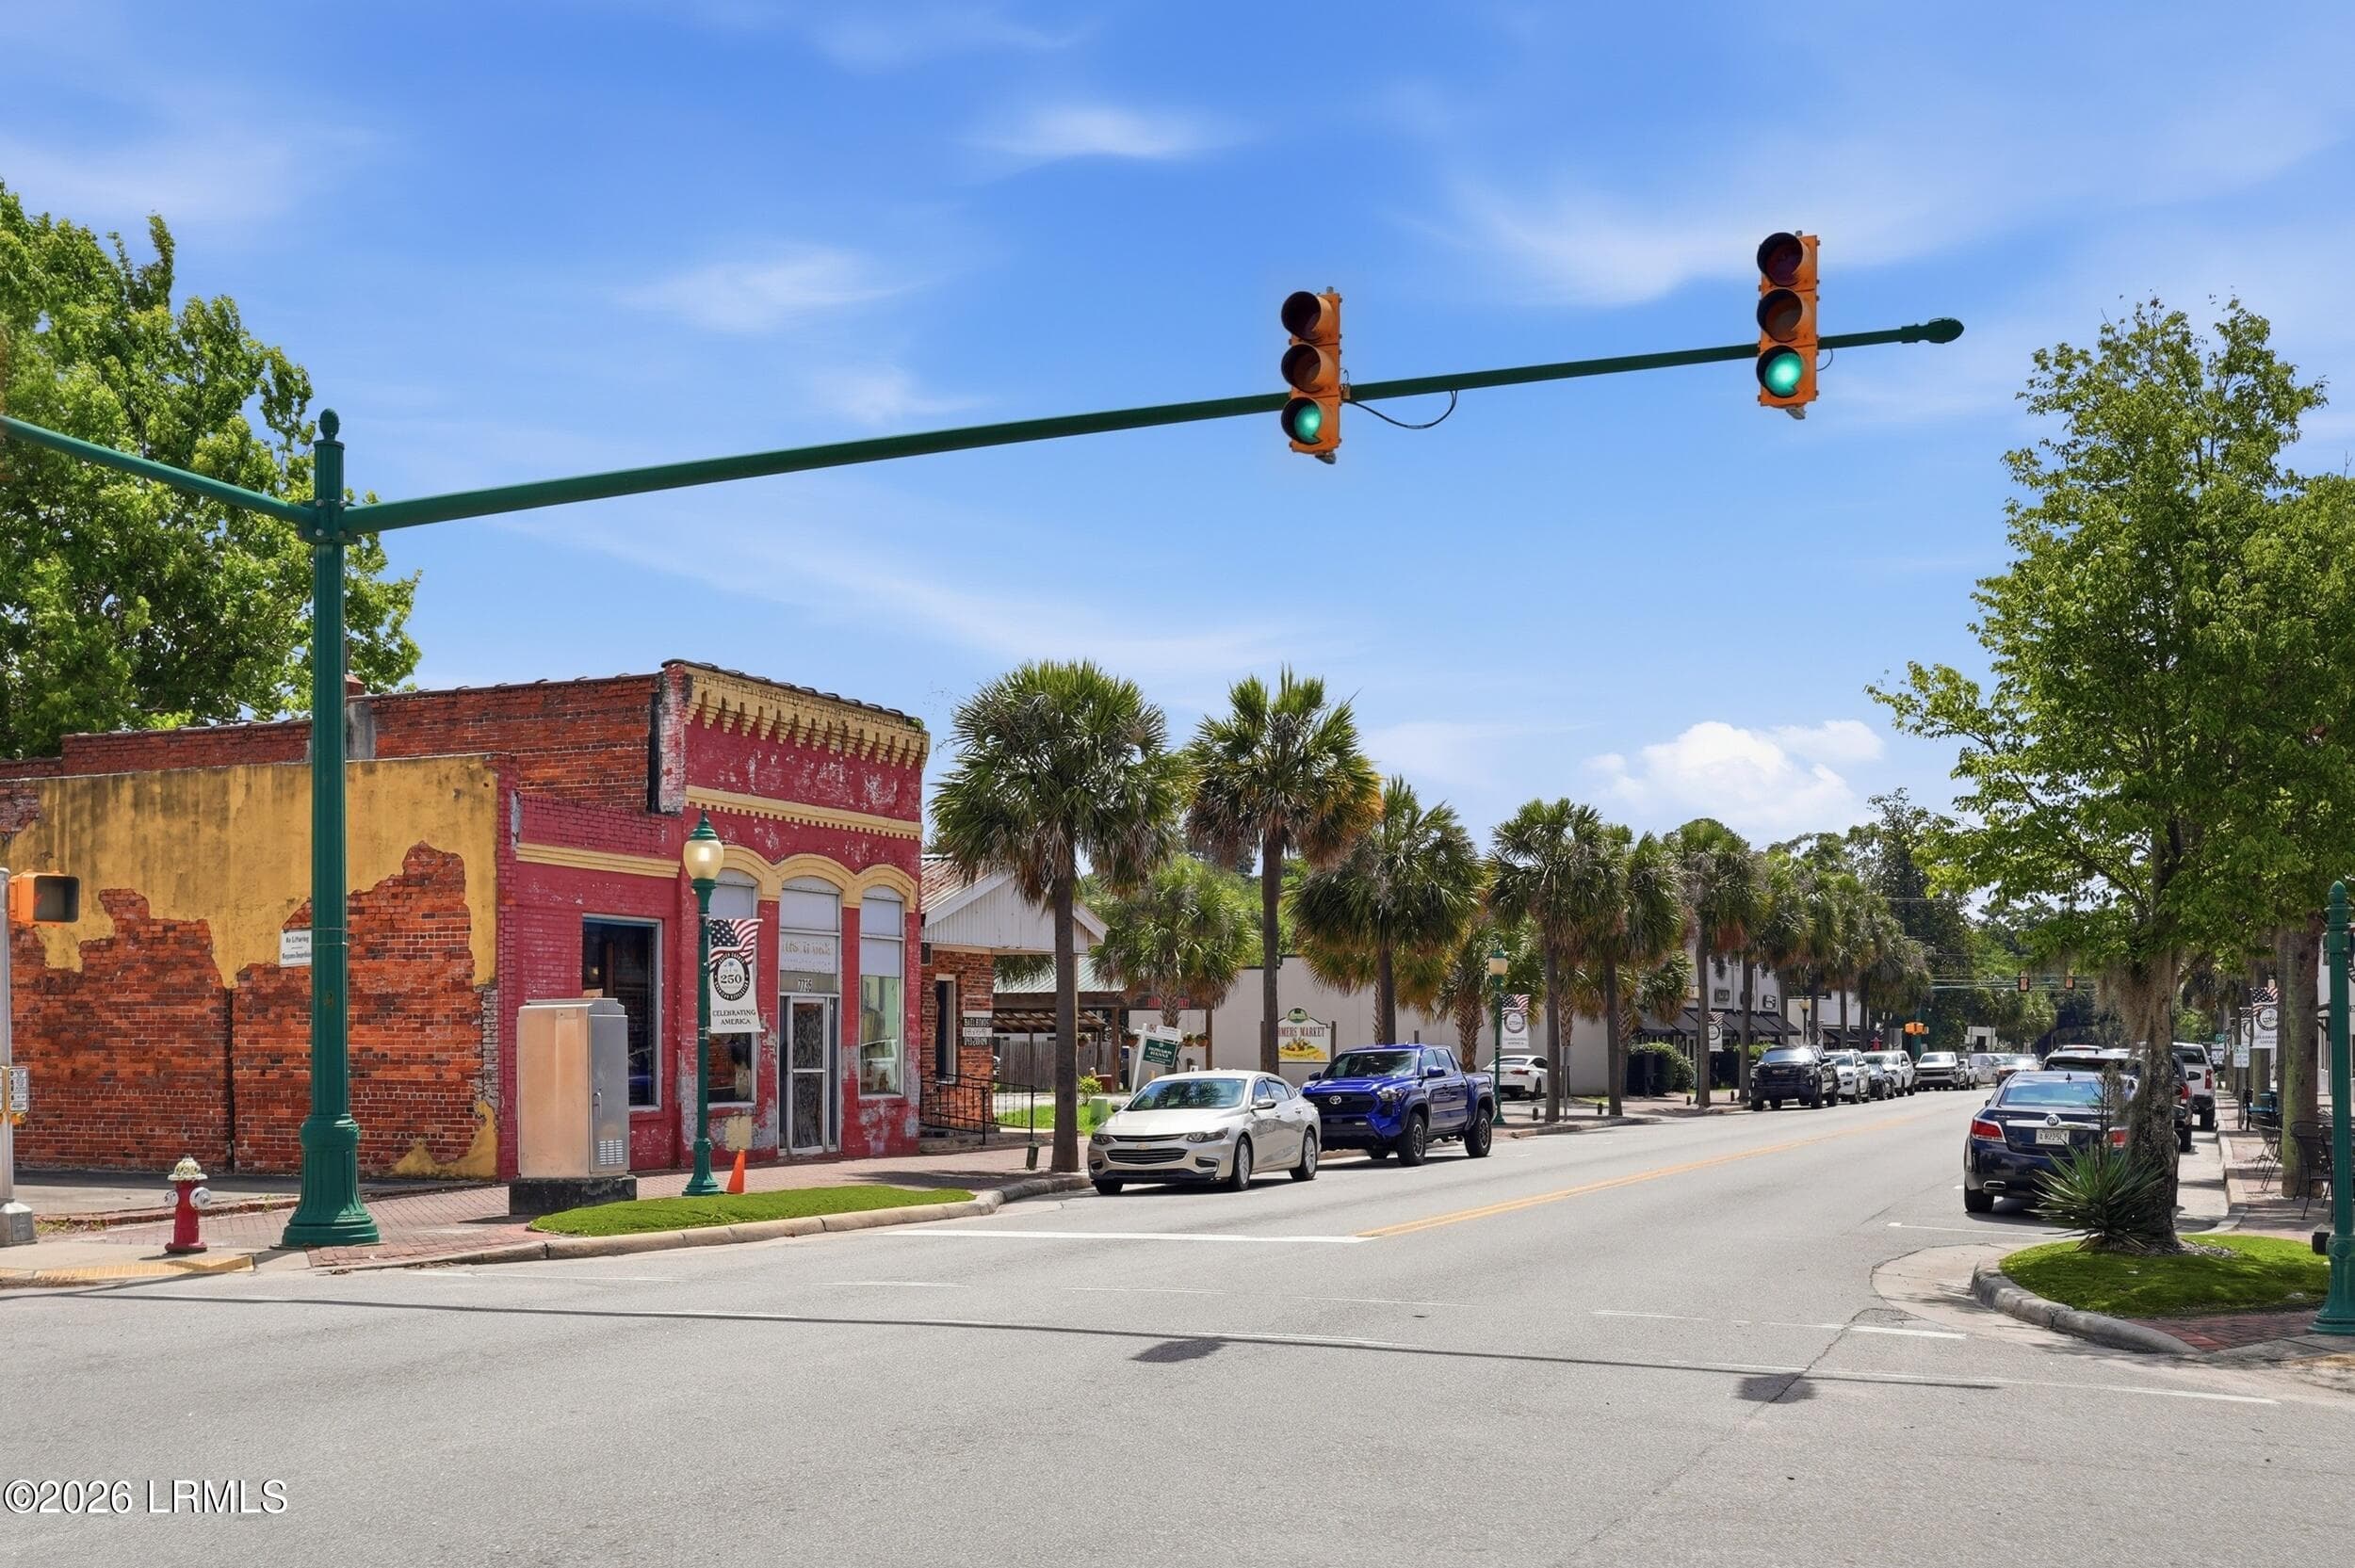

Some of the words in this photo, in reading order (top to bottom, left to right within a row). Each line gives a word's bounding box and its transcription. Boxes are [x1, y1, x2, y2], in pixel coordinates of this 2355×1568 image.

[721, 974, 742, 984] 250
[712, 1009, 756, 1017] CELEBRATING
[1300, 1026, 1325, 1037] MARKET
